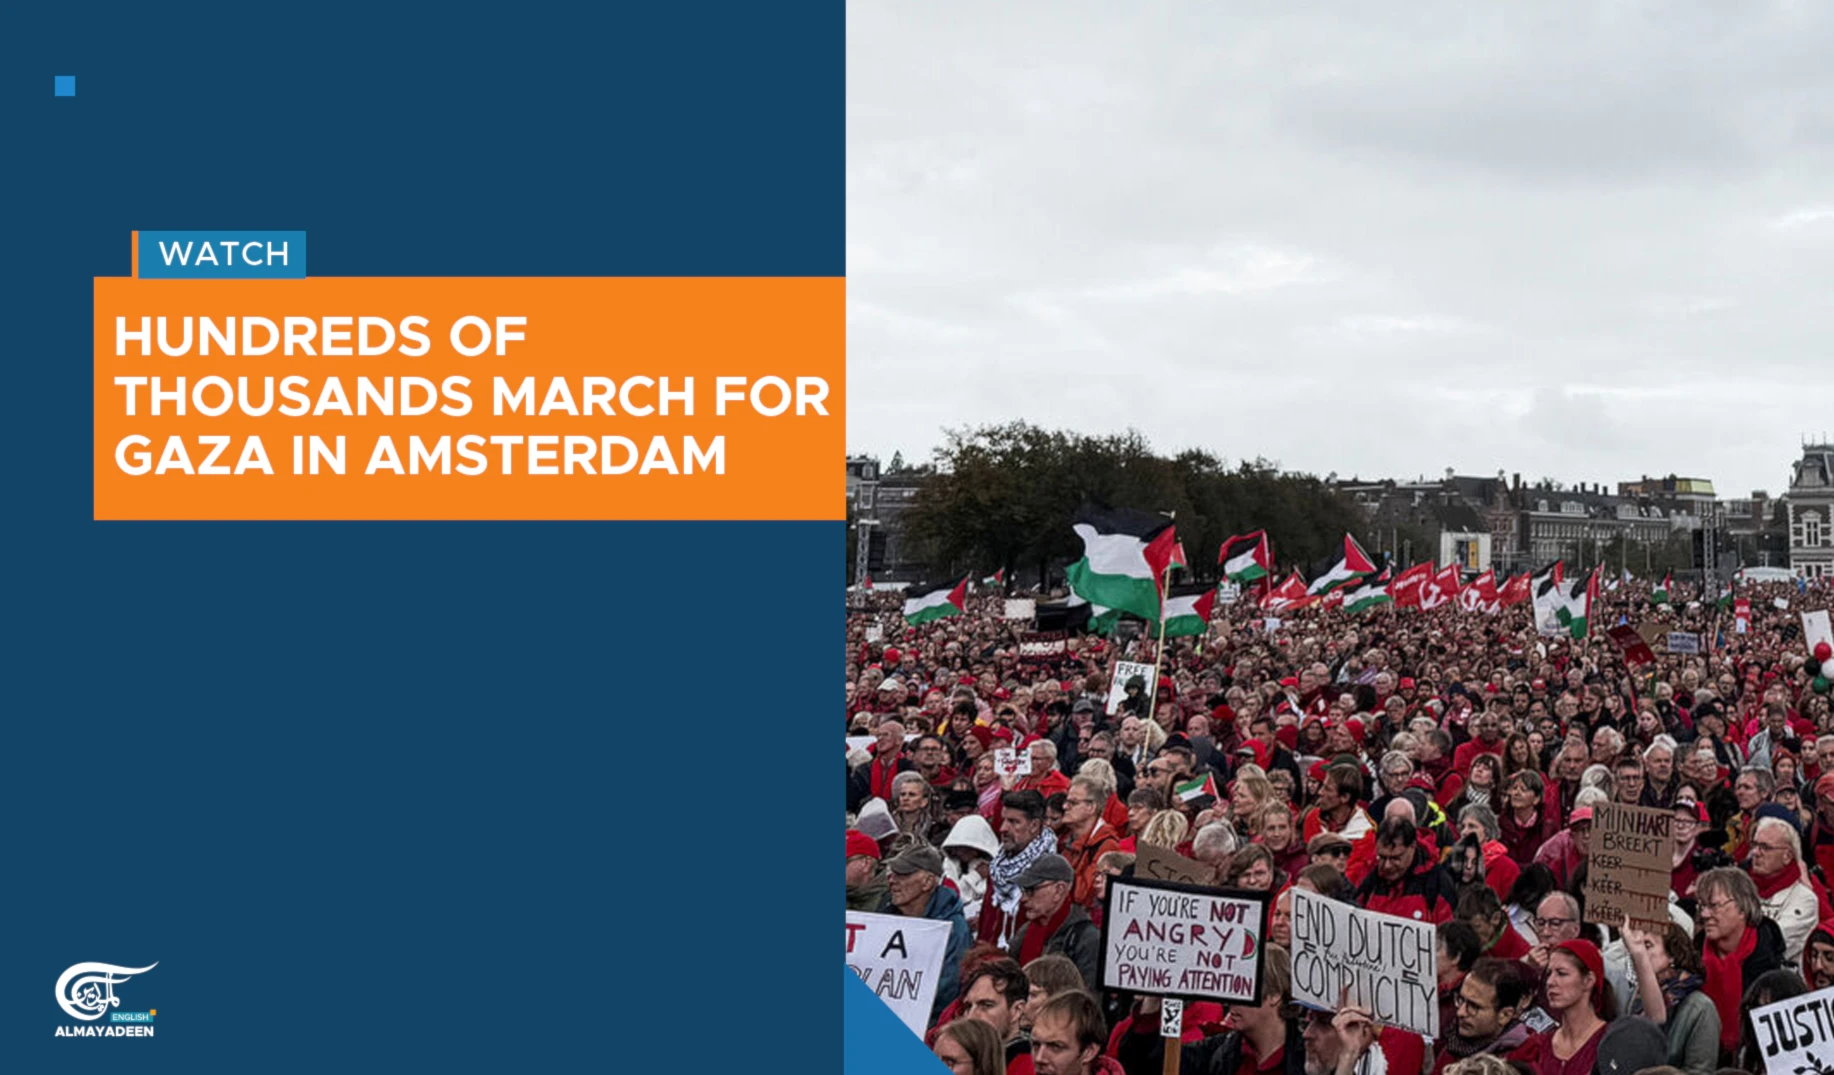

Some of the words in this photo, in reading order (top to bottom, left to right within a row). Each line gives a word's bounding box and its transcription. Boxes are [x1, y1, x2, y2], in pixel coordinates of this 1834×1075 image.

[1117, 663, 1148, 676] FREE
[1636, 812, 1674, 837] HART
[1603, 832, 1663, 856] BREEKT
[1592, 852, 1622, 870] KEER
[1592, 878, 1622, 895] KEER
[1119, 890, 1139, 914] IF
[1150, 893, 1200, 919] YOU'RE
[1210, 901, 1250, 924] NOT
[880, 929, 908, 959] A
[1123, 918, 1234, 952] ANGRY
[1295, 894, 1336, 947] END
[1349, 912, 1433, 977] DUTCH
[1115, 943, 1177, 964] YOU'RE
[1197, 950, 1236, 970] NOT
[1118, 963, 1172, 988] PAYING
[1178, 968, 1253, 996] ATTENTION
[1293, 950, 1436, 1036] COMPLICITY
[1758, 997, 1834, 1057] JUSTI
